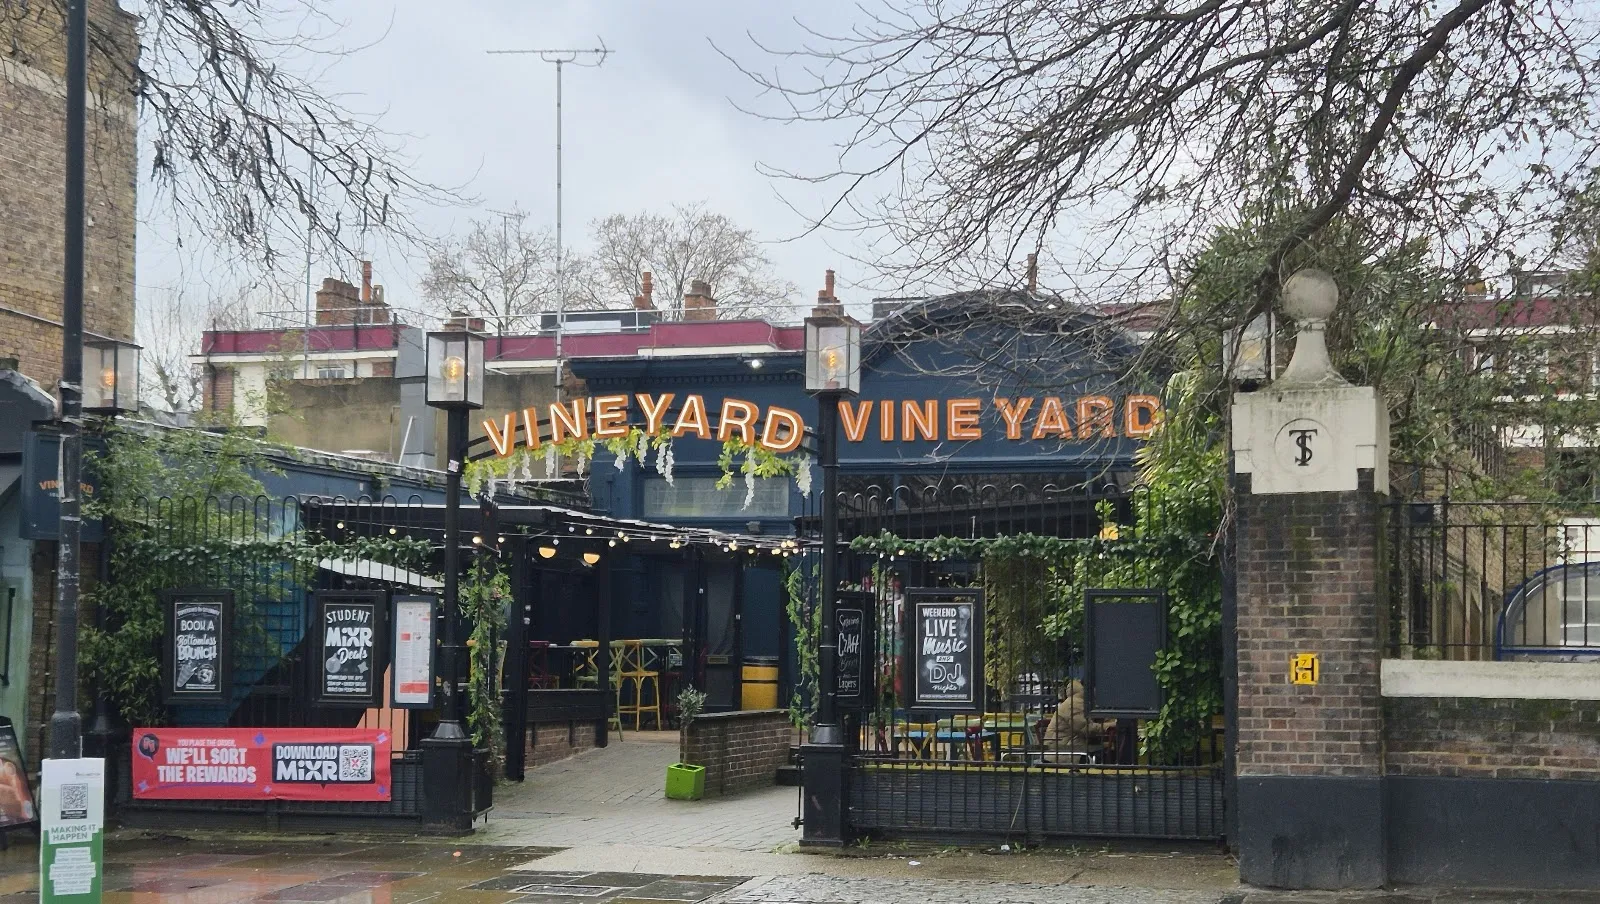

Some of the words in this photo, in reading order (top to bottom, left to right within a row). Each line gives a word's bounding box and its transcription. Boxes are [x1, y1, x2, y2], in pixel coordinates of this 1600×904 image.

[482, 393, 804, 458] VINEYARD
[837, 396, 1163, 442] VINEYARD
[326, 609, 370, 623] STUDENT
[922, 607, 957, 618] WEEKEND
[181, 620, 206, 631] BOOK
[207, 620, 215, 631] A
[925, 619, 957, 637] LIVE
[177, 634, 217, 647] Bottomless
[922, 637, 968, 656] Music
[337, 647, 368, 664] Deals
[929, 663, 964, 684] DJ
[838, 678, 857, 692] Lagers
[207, 739, 217, 747] THE
[210, 748, 248, 765] SORT
[276, 745, 338, 760] DOWNLOAD
[157, 765, 184, 783] THE
[186, 765, 257, 784] REWARDS
[51, 825, 87, 834] MAKING
[89, 824, 97, 832] IT
[53, 832, 88, 841] HAPPEN
